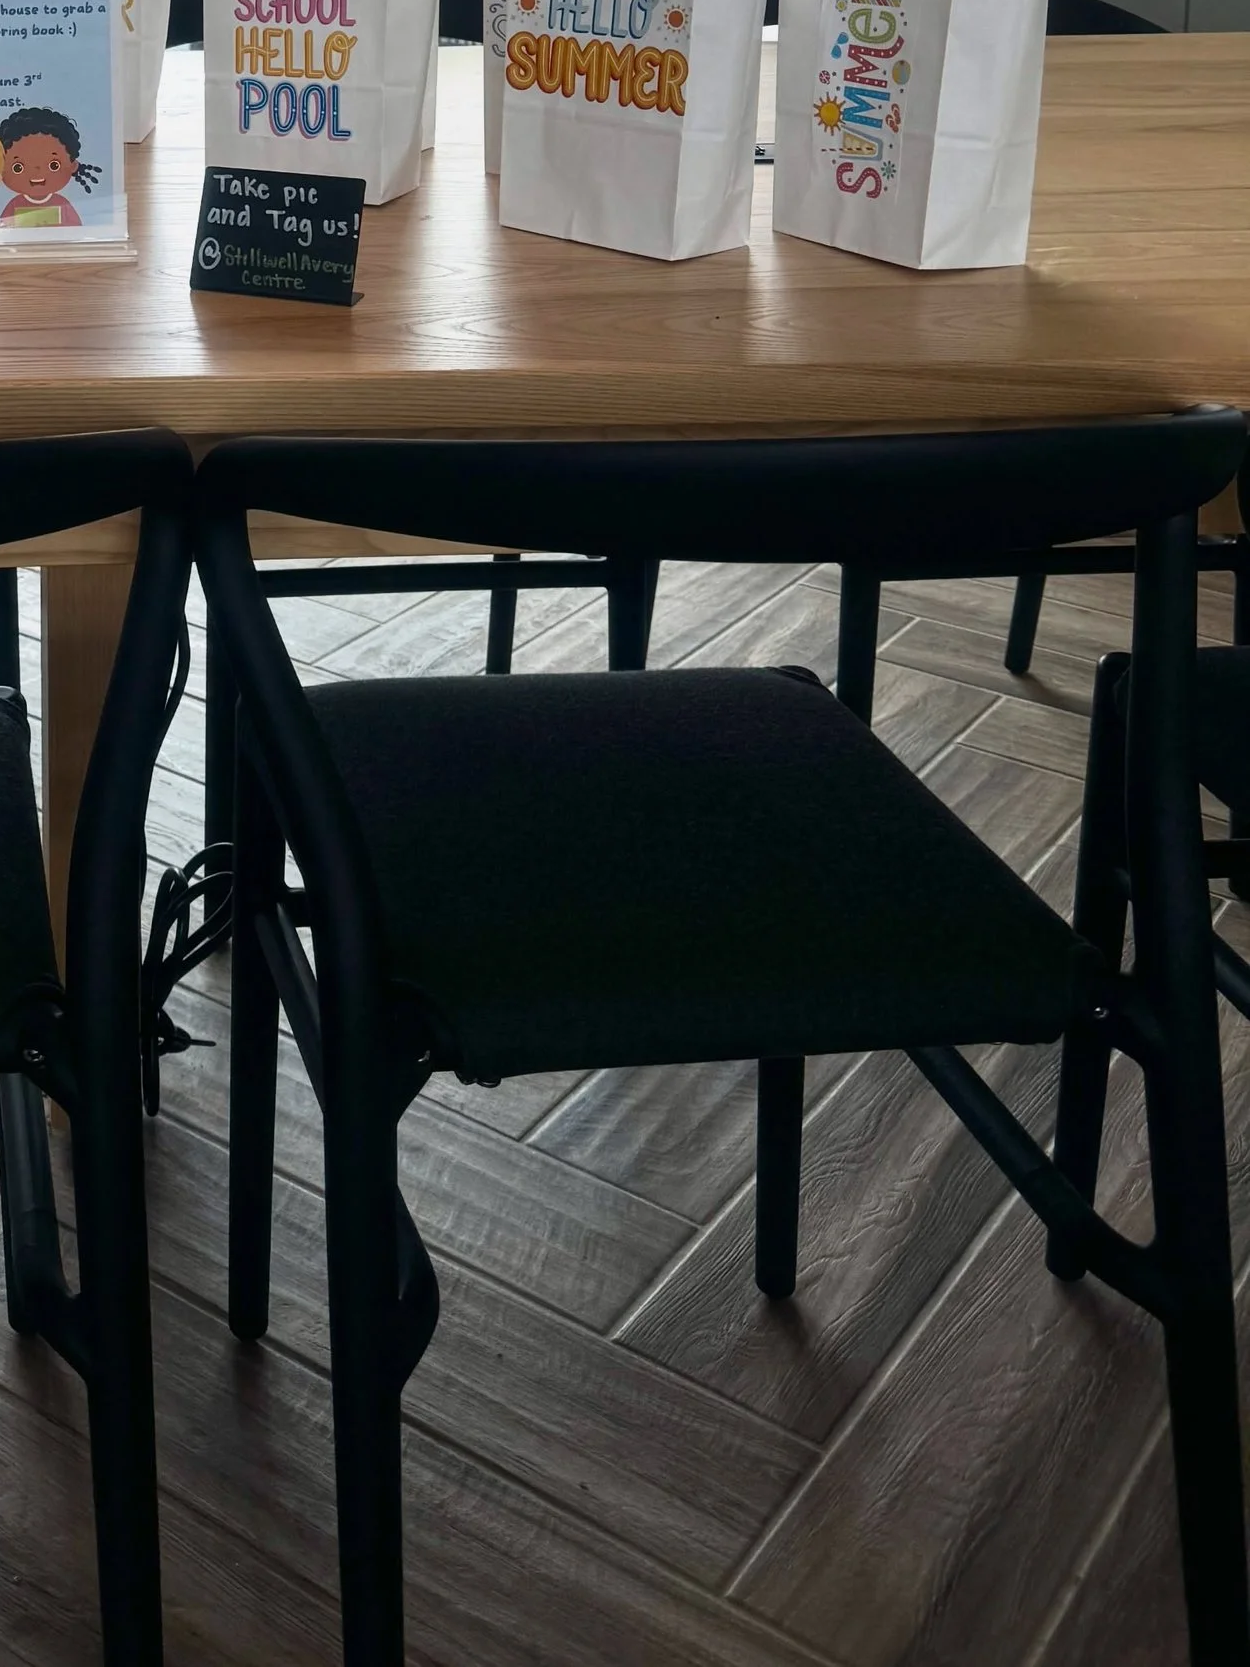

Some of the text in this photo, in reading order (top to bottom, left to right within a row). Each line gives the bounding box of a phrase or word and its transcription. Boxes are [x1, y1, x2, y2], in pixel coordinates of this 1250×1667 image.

[0, 4, 39, 16] house
[43, 4, 58, 15] to
[62, 1, 94, 18] grab
[97, 4, 106, 14] a
[31, 24, 64, 36] book
[234, 25, 358, 81] HELLO
[23, 72, 43, 87] 3rd
[506, 31, 689, 117] SUMMER
[237, 78, 353, 141] POOL
[213, 174, 319, 208] Take pic
[206, 204, 360, 247] and Tag us!
